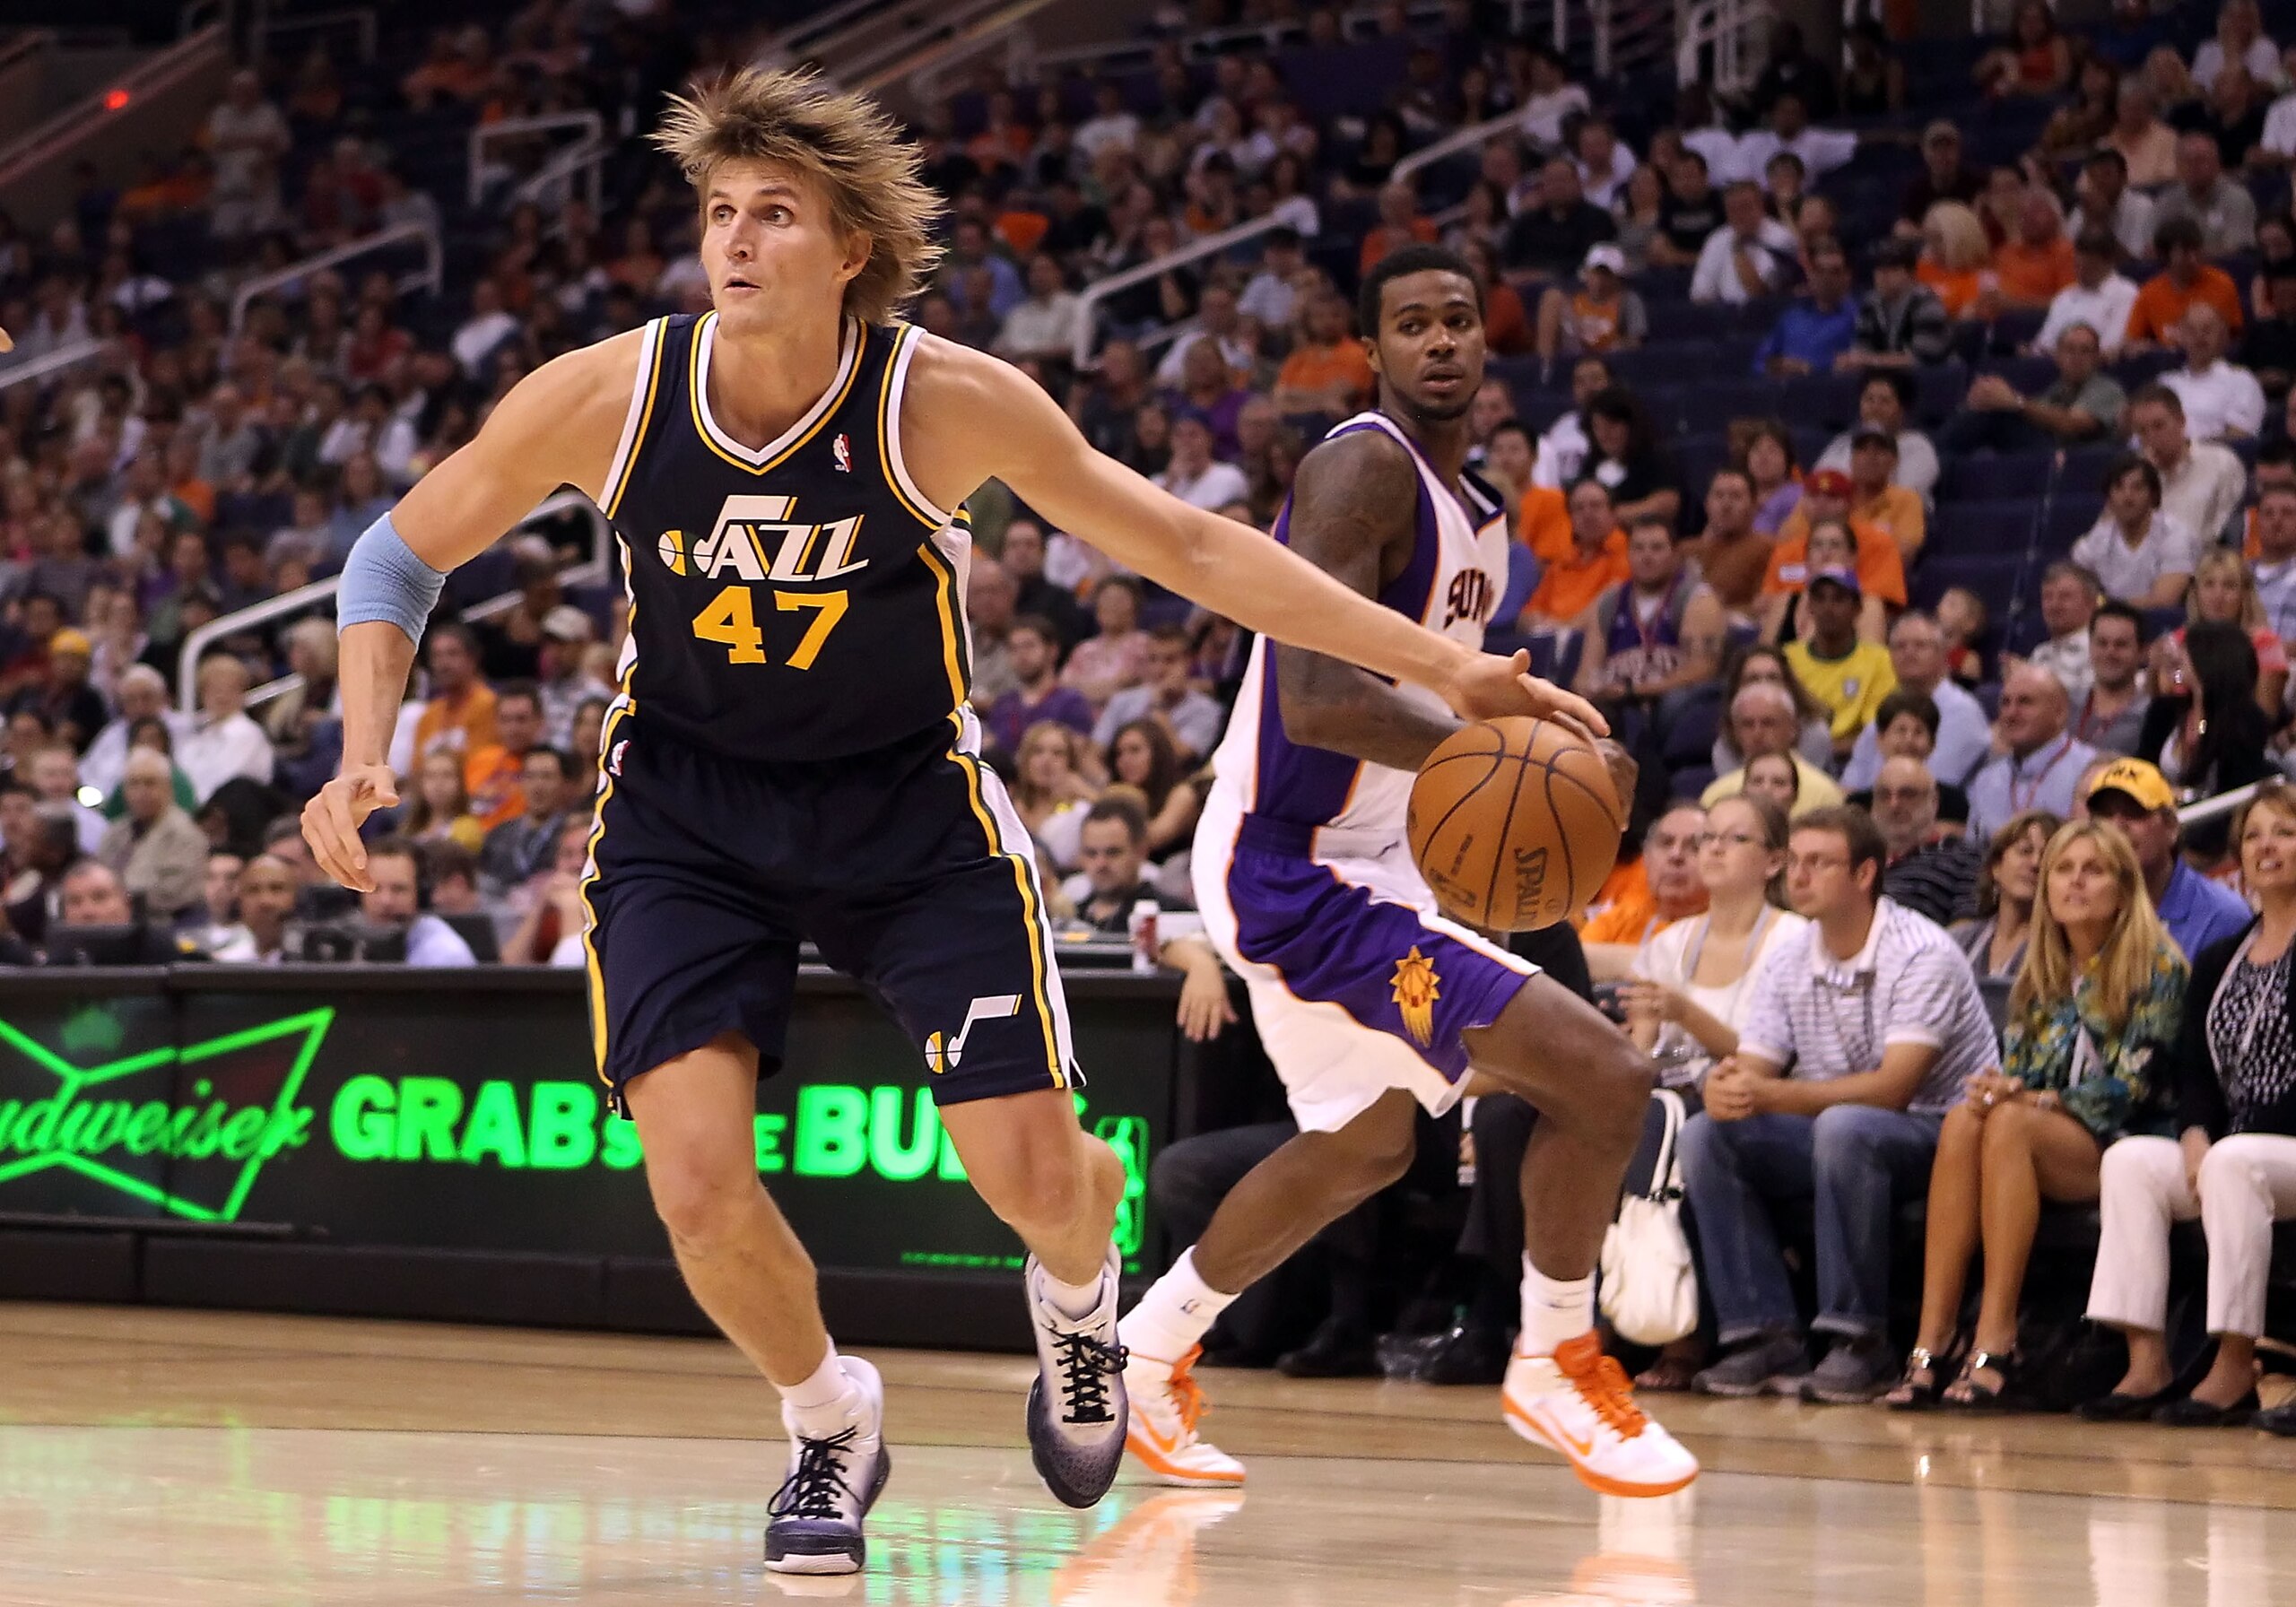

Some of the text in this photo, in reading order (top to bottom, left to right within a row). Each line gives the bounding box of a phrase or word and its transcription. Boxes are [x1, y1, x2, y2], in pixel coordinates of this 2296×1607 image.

[691, 494, 869, 582] JAZZ
[691, 585, 849, 671] 47
[1443, 569, 1494, 630] SUN
[329, 1073, 599, 1169] GRAB
